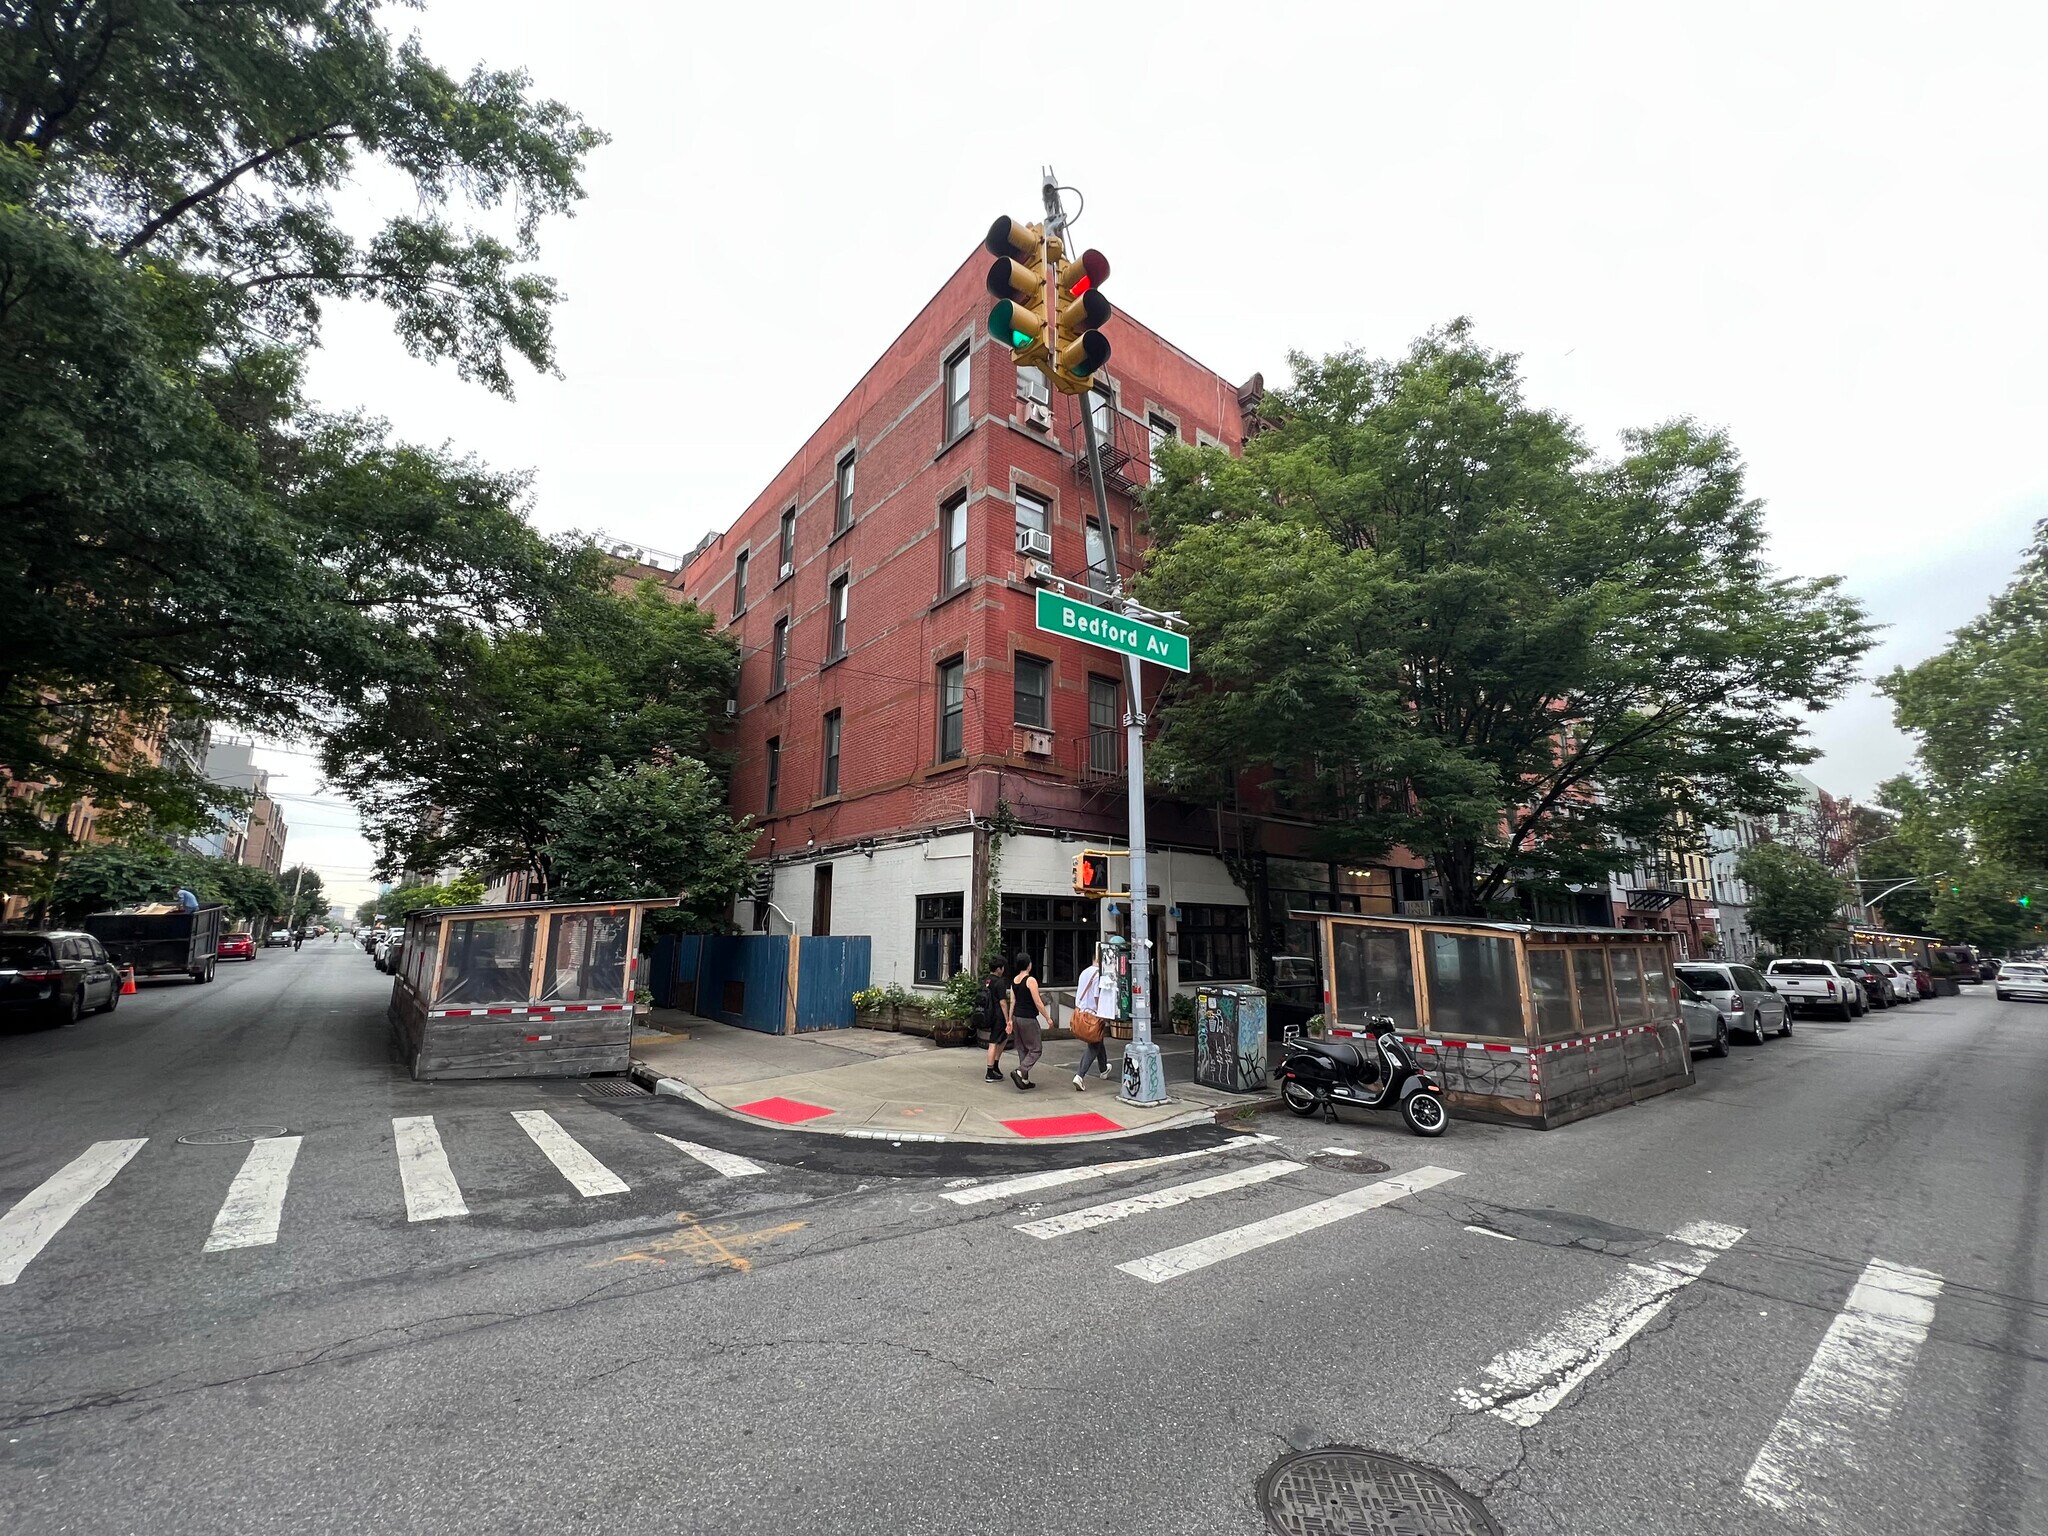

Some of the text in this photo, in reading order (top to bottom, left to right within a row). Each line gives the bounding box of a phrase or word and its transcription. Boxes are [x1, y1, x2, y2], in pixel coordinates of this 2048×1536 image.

[1062, 608, 1170, 657] Bedford Av
[1295, 1503, 1385, 1524] SEWER
